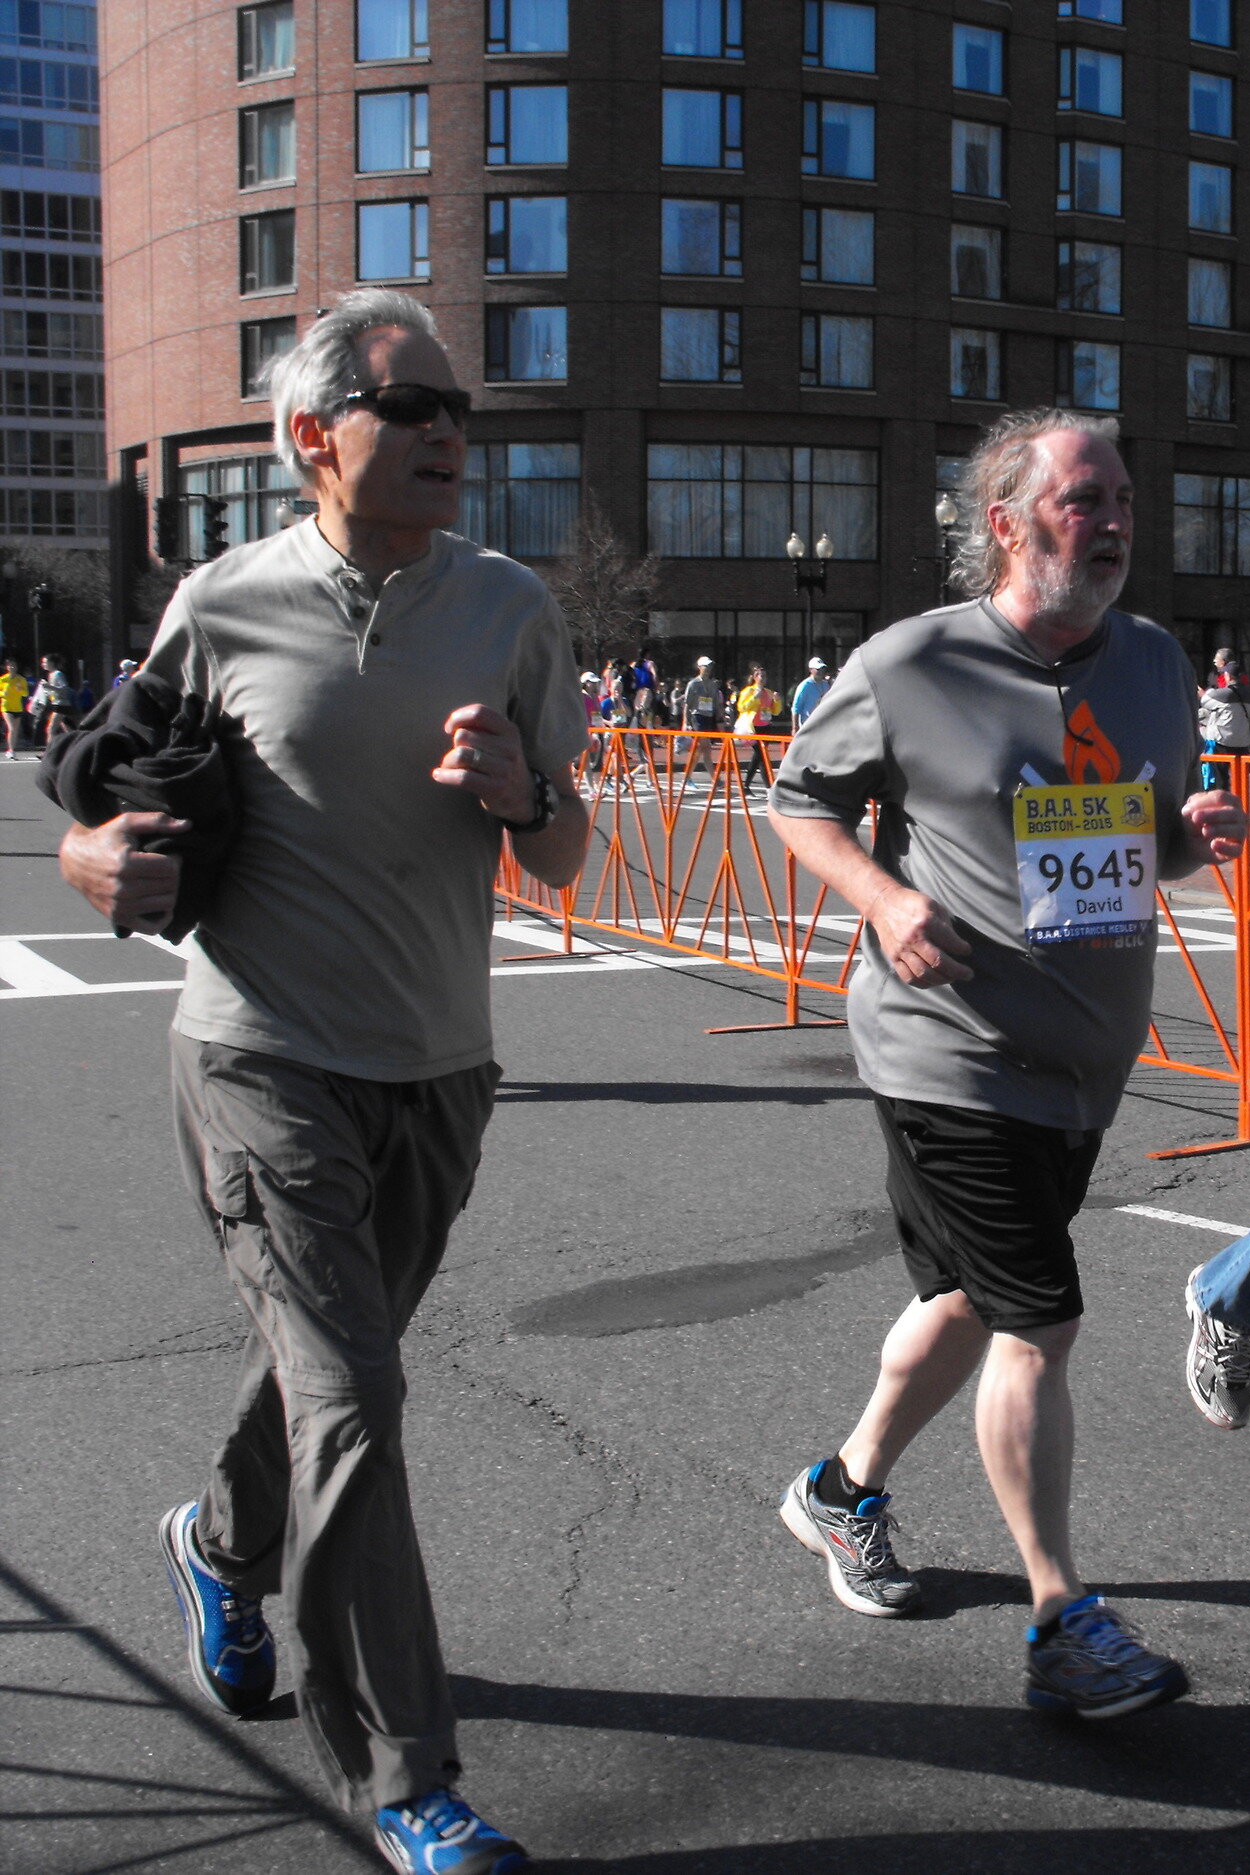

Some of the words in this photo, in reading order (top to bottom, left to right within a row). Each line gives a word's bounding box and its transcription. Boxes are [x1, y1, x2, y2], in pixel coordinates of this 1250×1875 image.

[1026, 798, 1077, 819] B.A.A.
[1082, 796, 1110, 816] 5K
[1038, 848, 1145, 894] 9645
[1076, 898, 1123, 914] David
